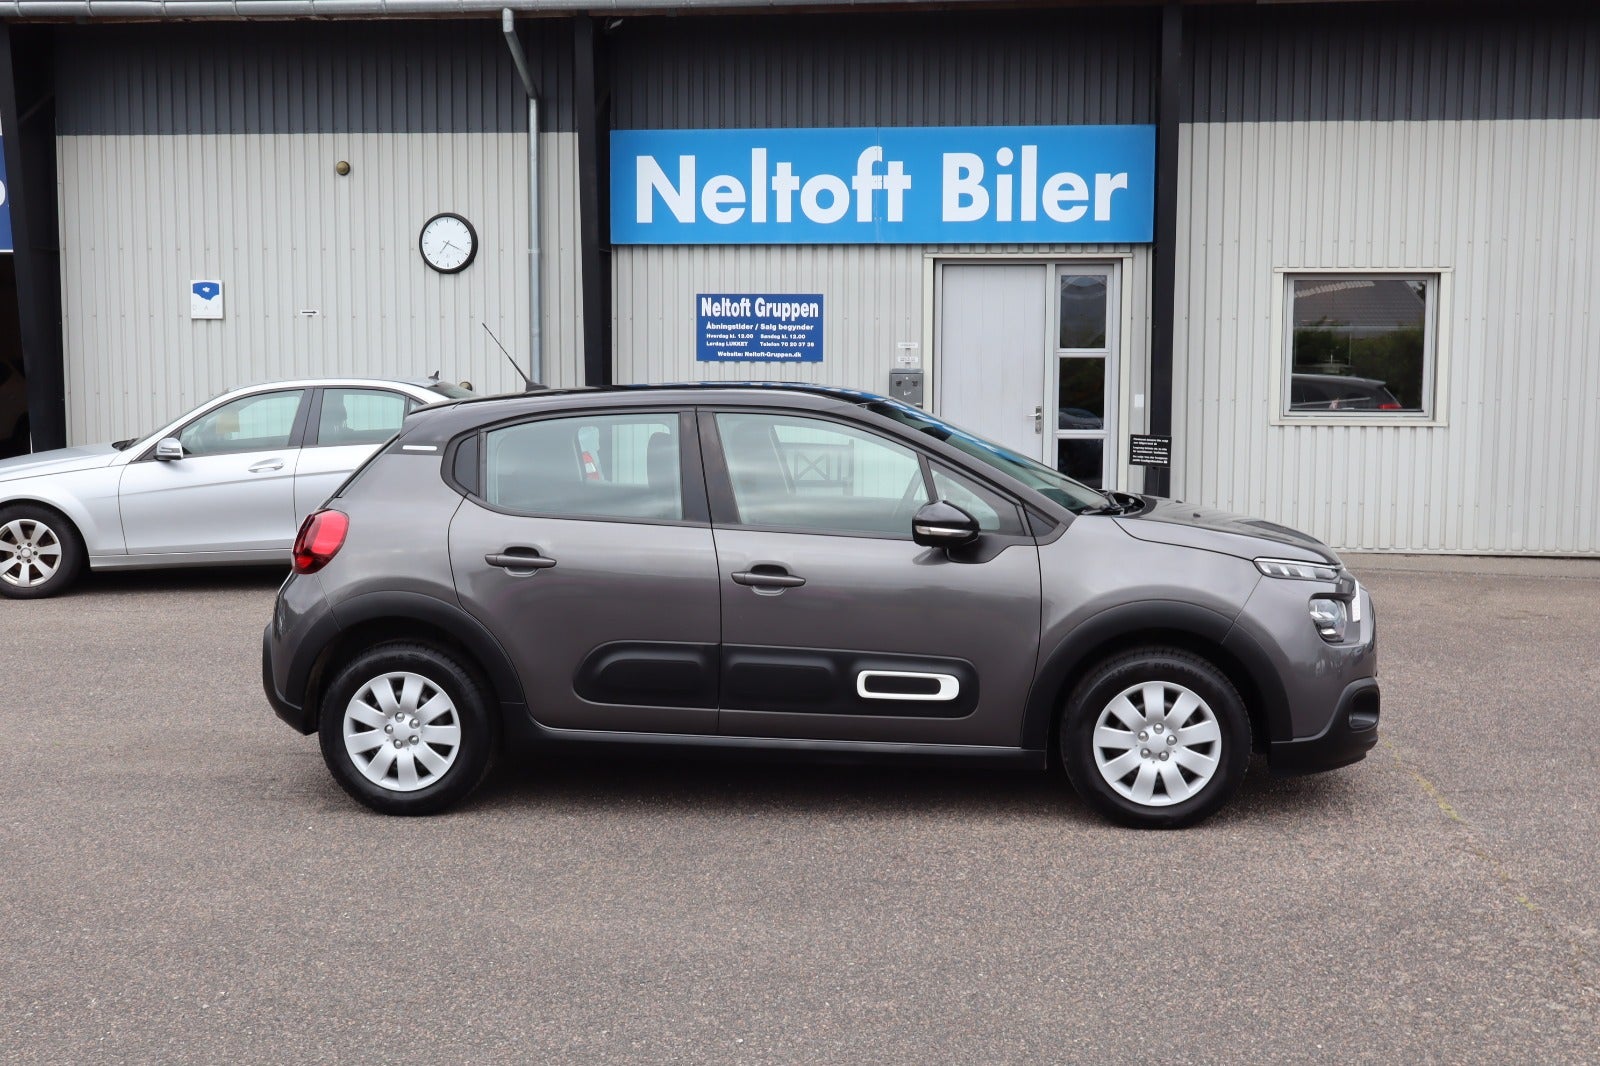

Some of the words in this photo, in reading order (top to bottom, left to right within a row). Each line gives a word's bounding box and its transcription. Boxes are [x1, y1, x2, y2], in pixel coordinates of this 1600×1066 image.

[636, 145, 912, 224] Neltoft
[942, 145, 1128, 222] Biler
[701, 297, 752, 317] Neltoft
[754, 297, 819, 321] Gruppen
[706, 321, 754, 331] Åbningstider
[760, 323, 777, 331] Salg
[778, 323, 814, 331] begynder
